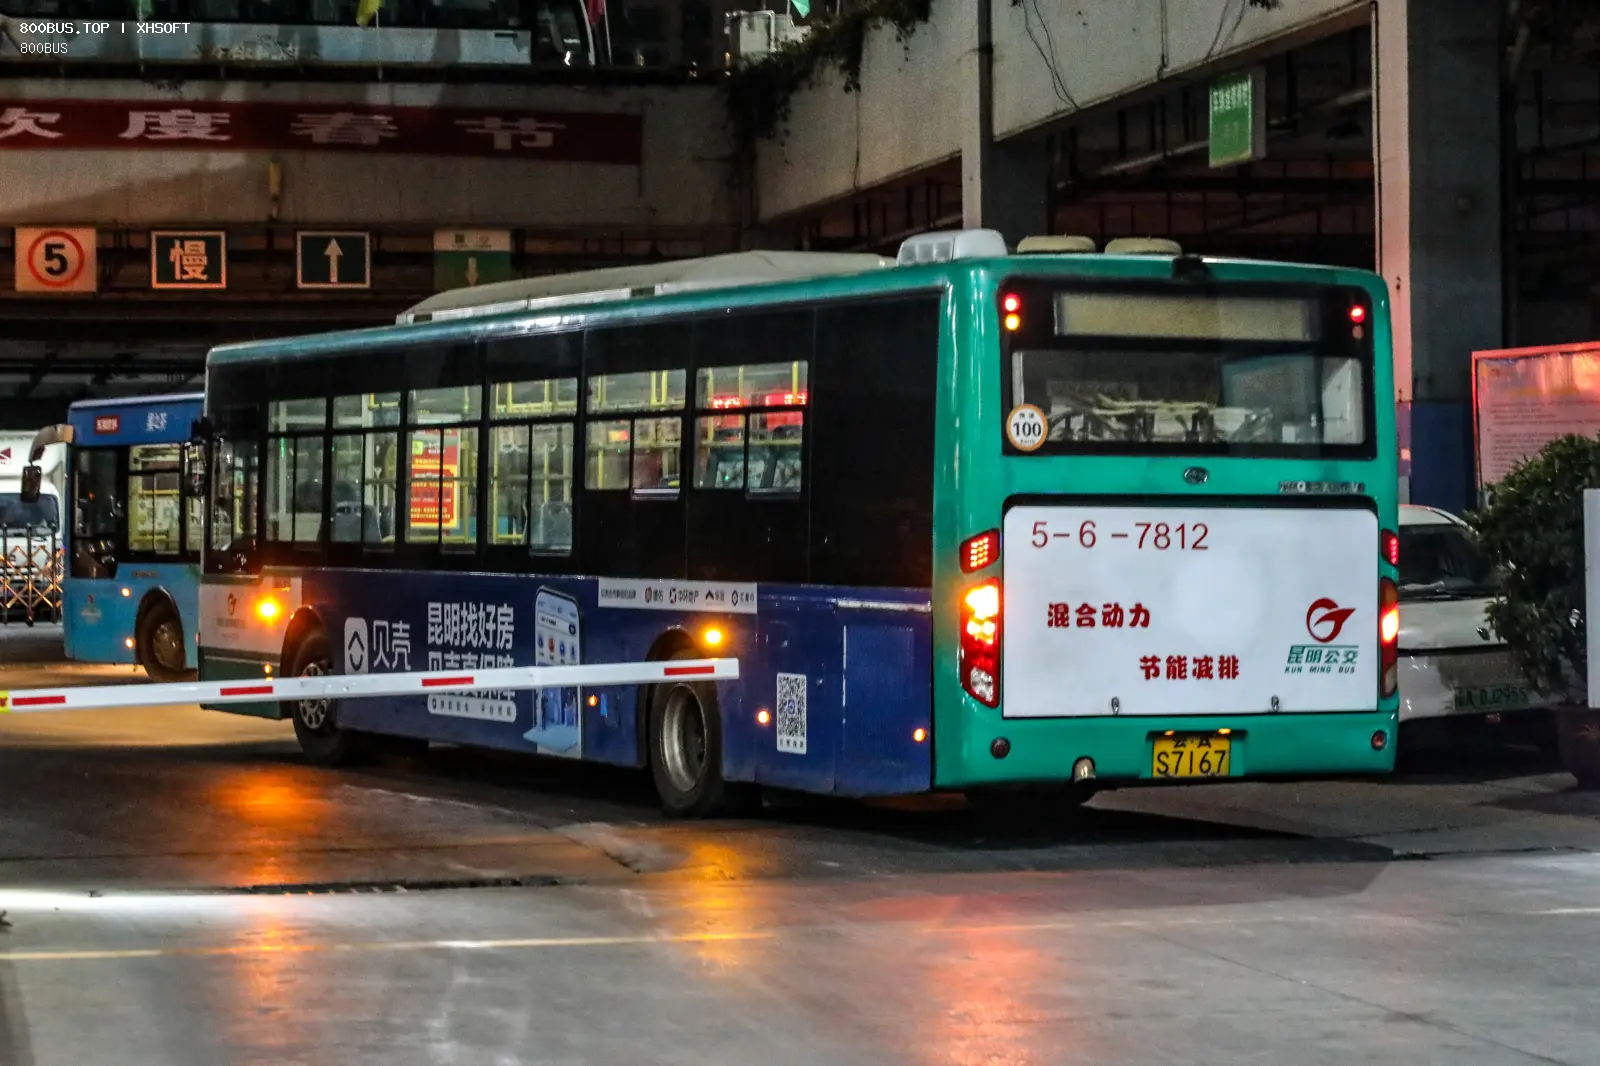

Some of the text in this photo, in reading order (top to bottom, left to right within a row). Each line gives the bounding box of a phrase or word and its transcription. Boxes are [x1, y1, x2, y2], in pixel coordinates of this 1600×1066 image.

[44, 243, 68, 276] 5
[169, 239, 208, 281] 慢
[1012, 421, 1042, 437] 100
[427, 602, 515, 650] 昆明找好房
[1047, 602, 1151, 628] 混合动力
[373, 619, 412, 671] 贝壳
[1287, 645, 1359, 664] 昆明公交
[1139, 654, 1240, 681] 节能减排
[1284, 666, 1356, 674] KUN MING BUS
[1157, 750, 1227, 775] S7167
